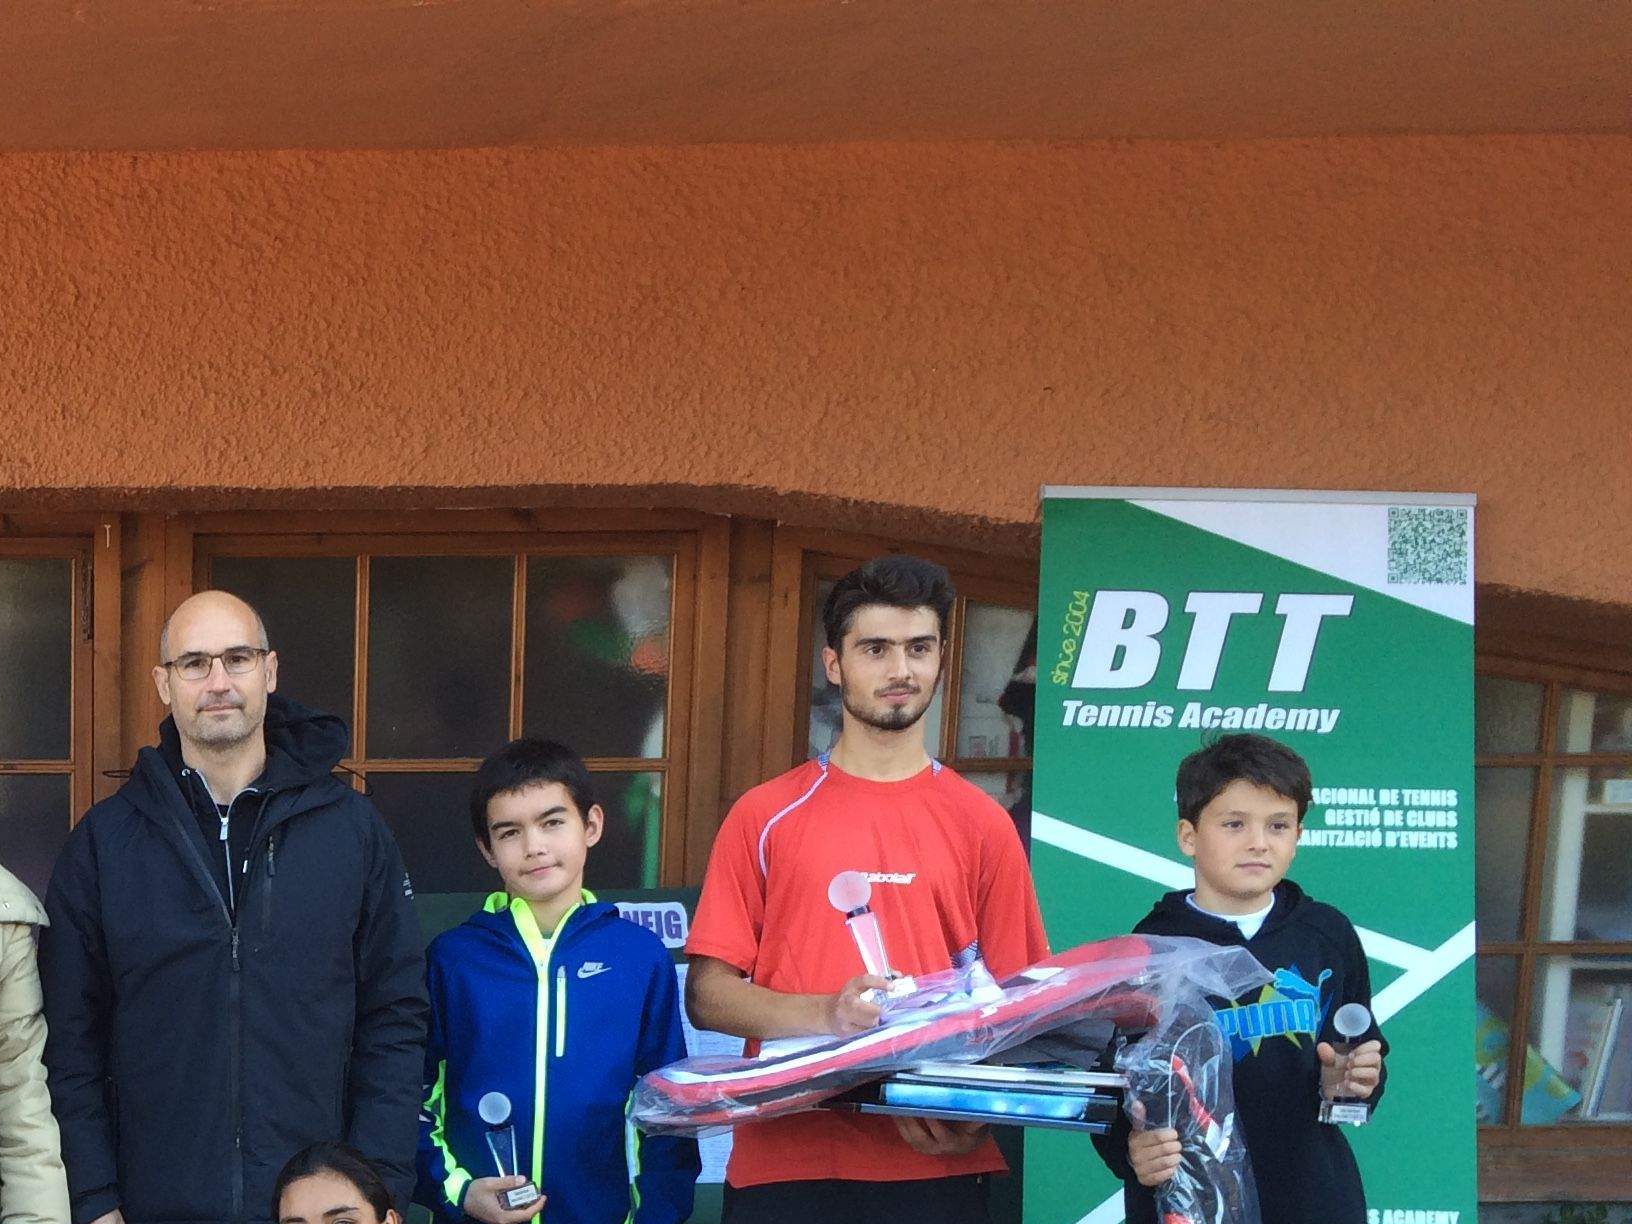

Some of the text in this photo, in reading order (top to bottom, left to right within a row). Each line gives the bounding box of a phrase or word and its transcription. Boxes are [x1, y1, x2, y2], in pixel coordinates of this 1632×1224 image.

[1063, 590, 1090, 637] 2004
[1070, 589, 1355, 692] BTT
[1062, 700, 1340, 734] Tennis Academy
[1311, 787, 1458, 807] ACIONAL DE TENNIS
[1383, 809, 1404, 827] DE
[1406, 810, 1458, 828] CLUBS
[1297, 827, 1383, 848] ANITZACIÓ
